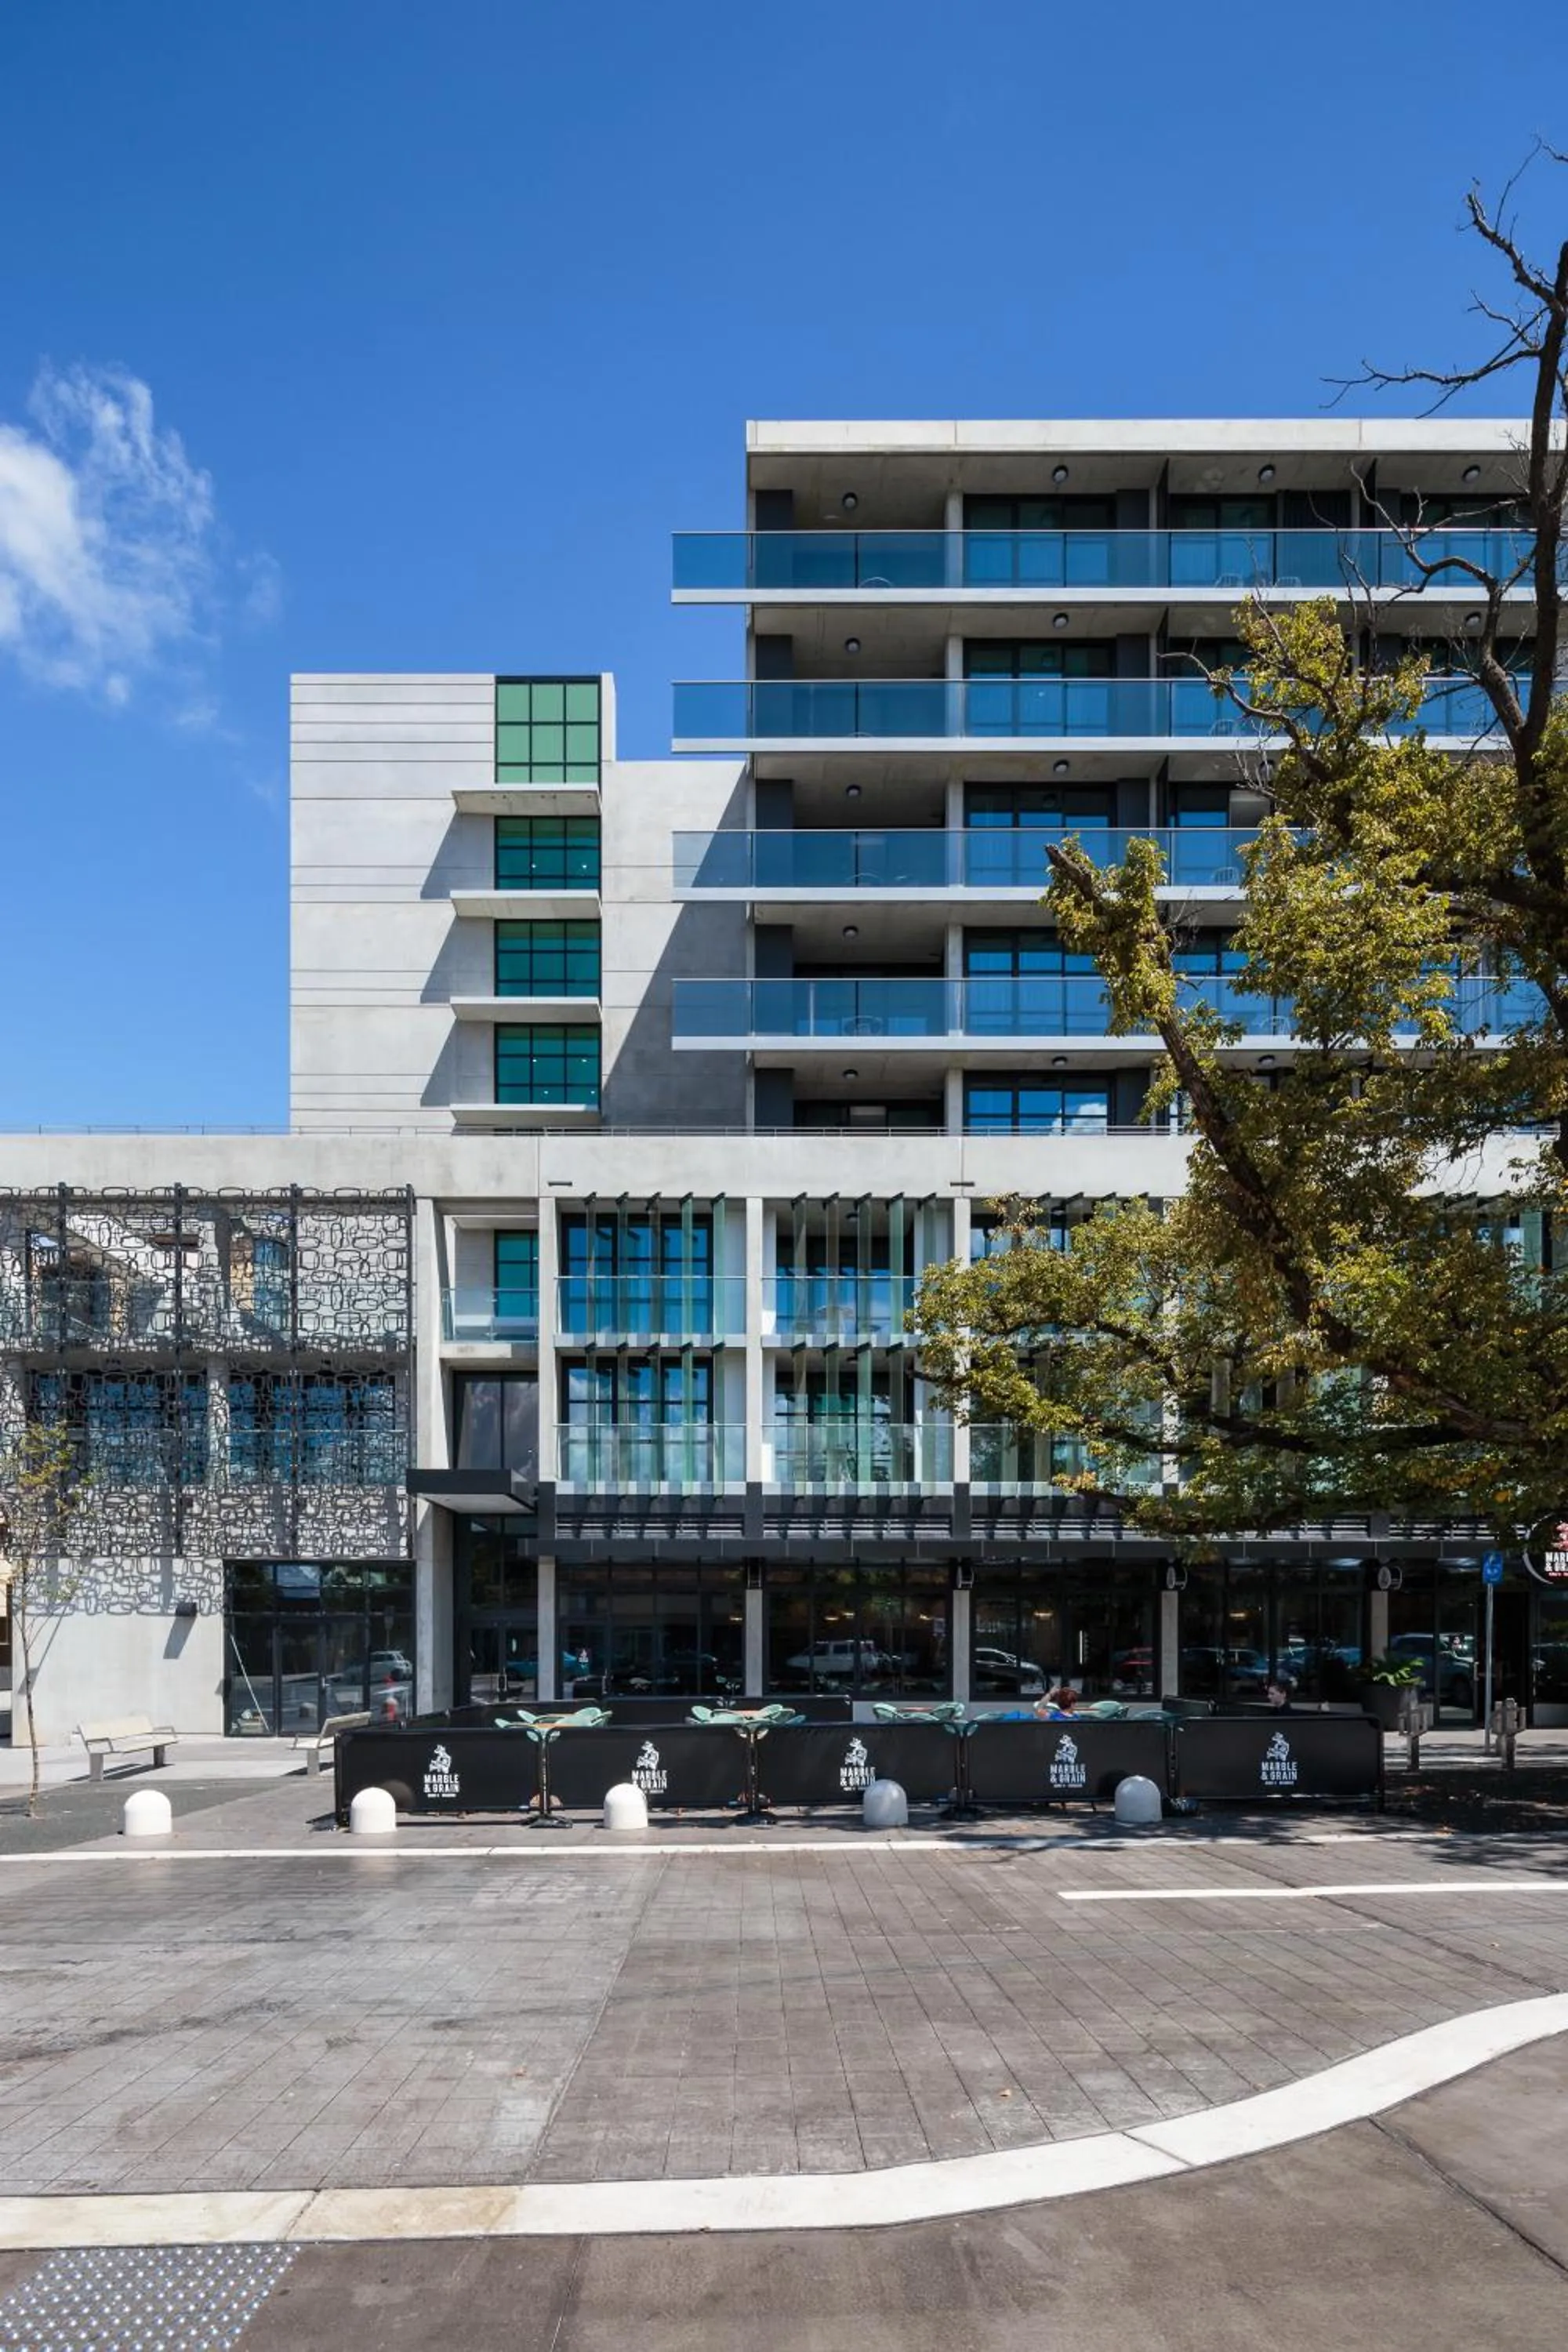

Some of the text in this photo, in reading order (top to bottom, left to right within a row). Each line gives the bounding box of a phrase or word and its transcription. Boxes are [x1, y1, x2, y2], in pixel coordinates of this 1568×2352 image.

[1261, 1762, 1298, 1770] MARBLE
[632, 1770, 667, 1780] MARBLE
[840, 1767, 876, 1777] MARBLE
[1261, 1771, 1298, 1780] & GRAIN
[424, 1774, 459, 1784] MARBLE
[840, 1777, 847, 1786] &
[424, 1784, 459, 1793] & GRAIN
